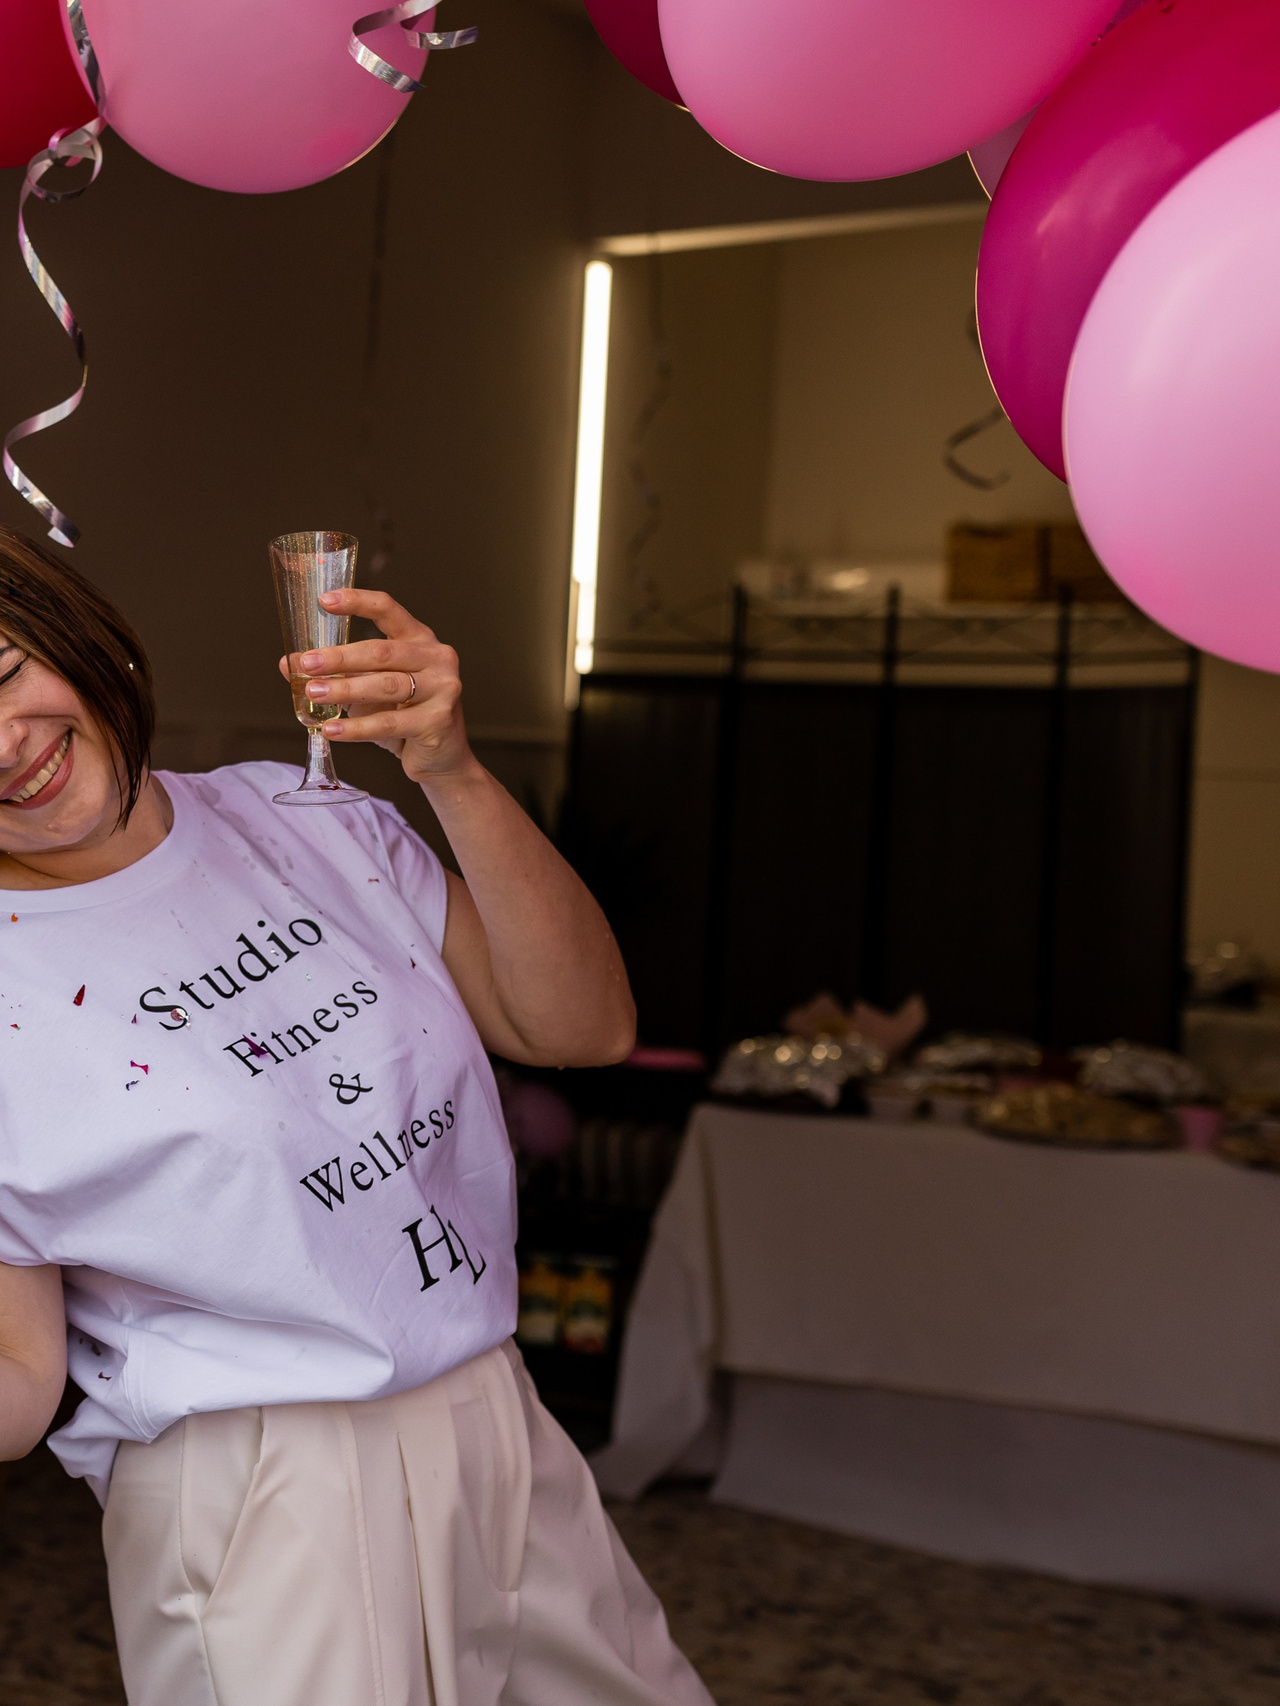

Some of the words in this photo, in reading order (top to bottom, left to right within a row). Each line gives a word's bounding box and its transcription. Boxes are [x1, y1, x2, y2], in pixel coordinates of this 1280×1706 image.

[139, 917, 323, 1031] Studio
[222, 980, 378, 1077] Fitness
[328, 1072, 374, 1105] &
[299, 1099, 455, 1213] Wellness
